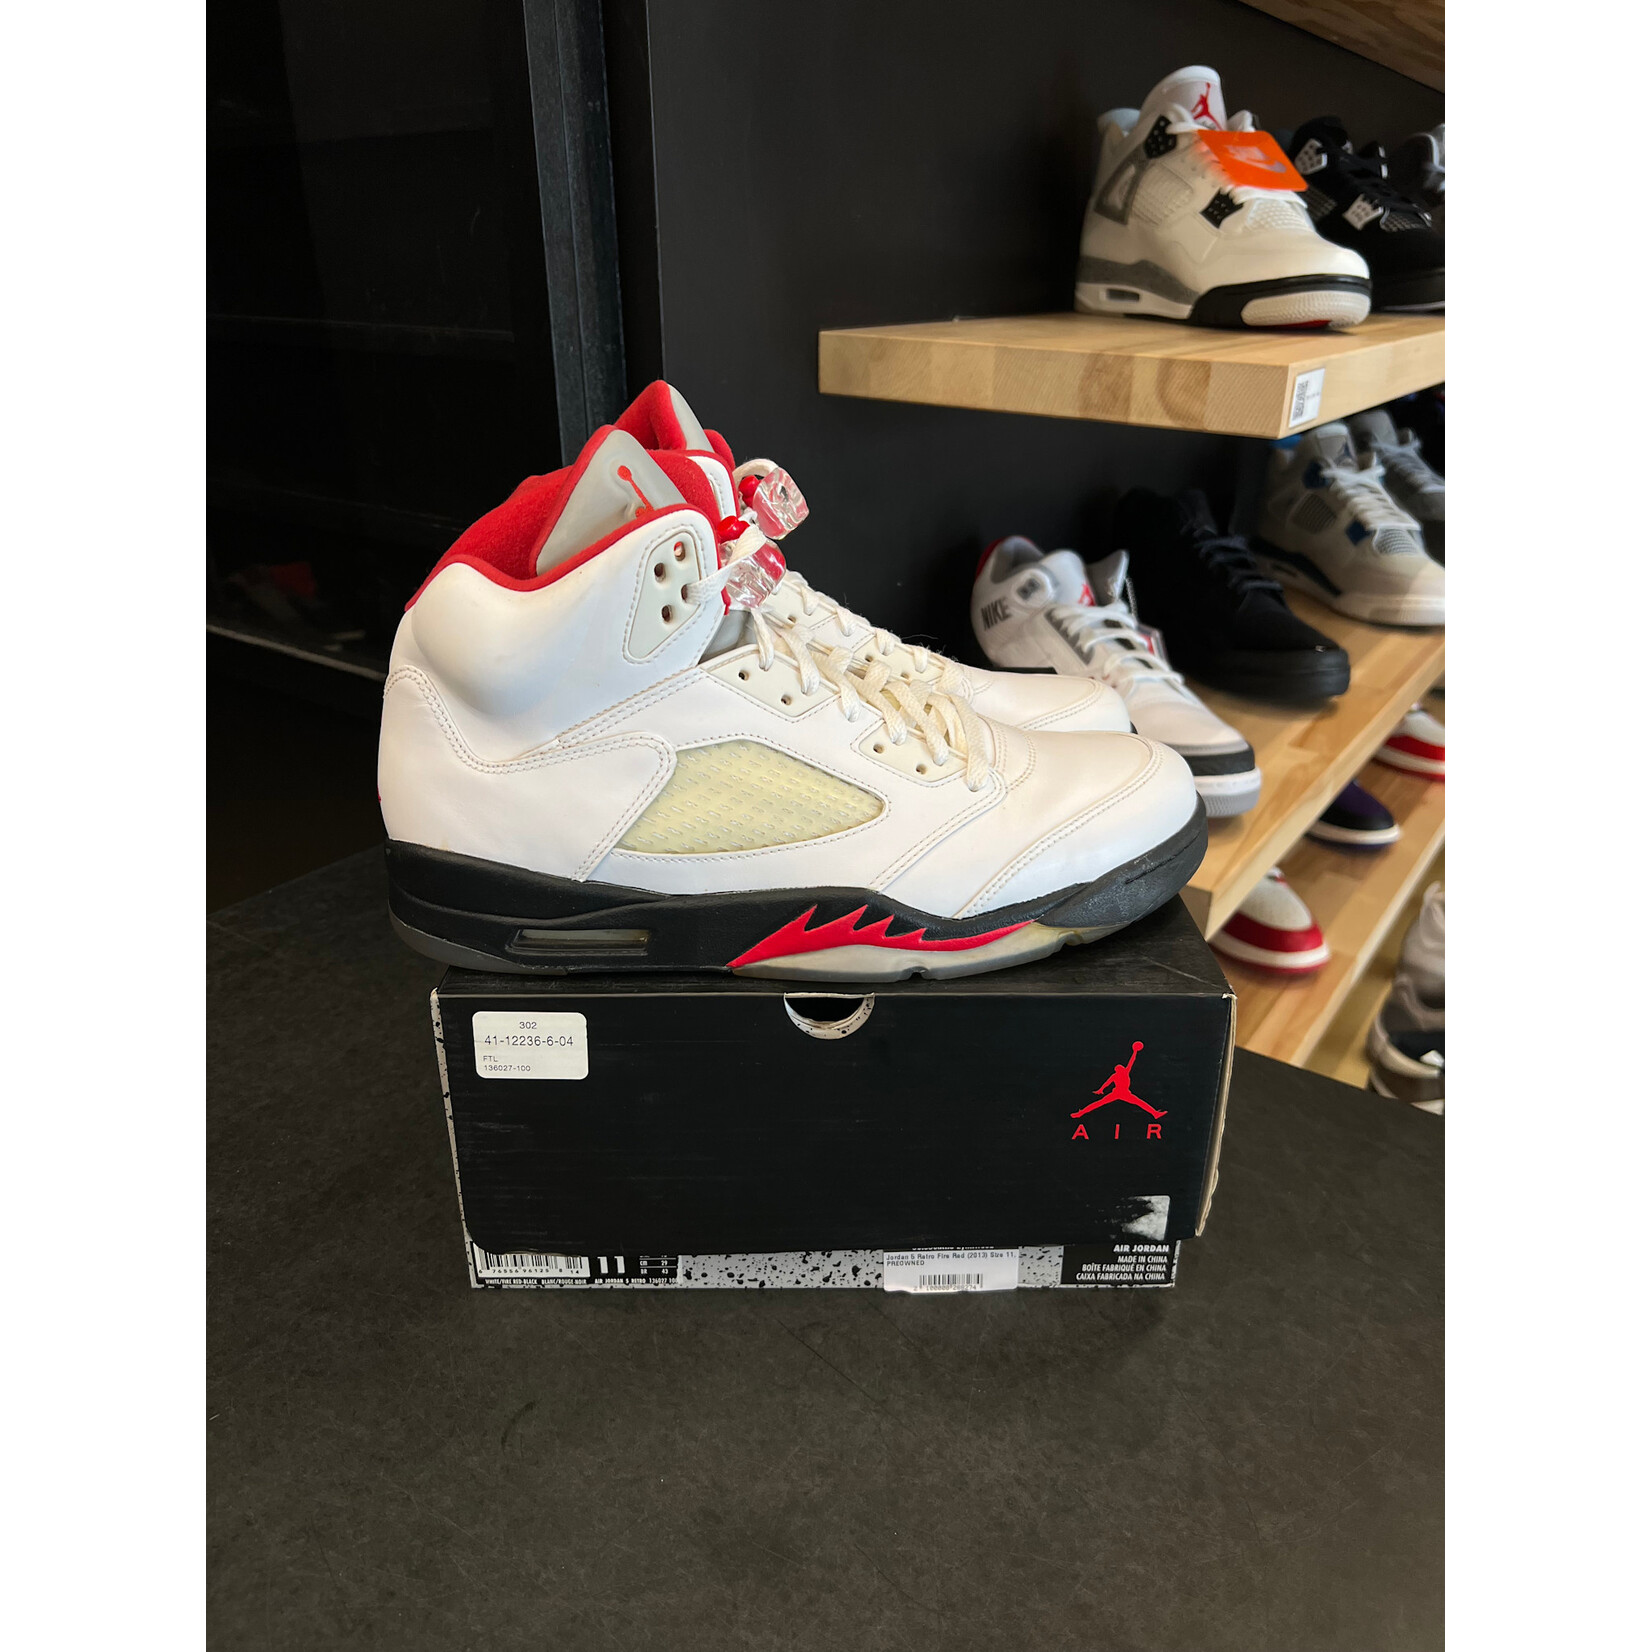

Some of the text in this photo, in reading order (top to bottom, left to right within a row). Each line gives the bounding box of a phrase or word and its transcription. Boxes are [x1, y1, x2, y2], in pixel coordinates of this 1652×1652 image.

[981, 598, 1012, 631] NIKE
[519, 1021, 537, 1030] 302
[484, 1035, 574, 1047] 41-12236-6-04
[1072, 1124, 1162, 1140] AIR
[597, 1256, 625, 1273] 11
[1082, 1262, 1101, 1272] BOÎTE
